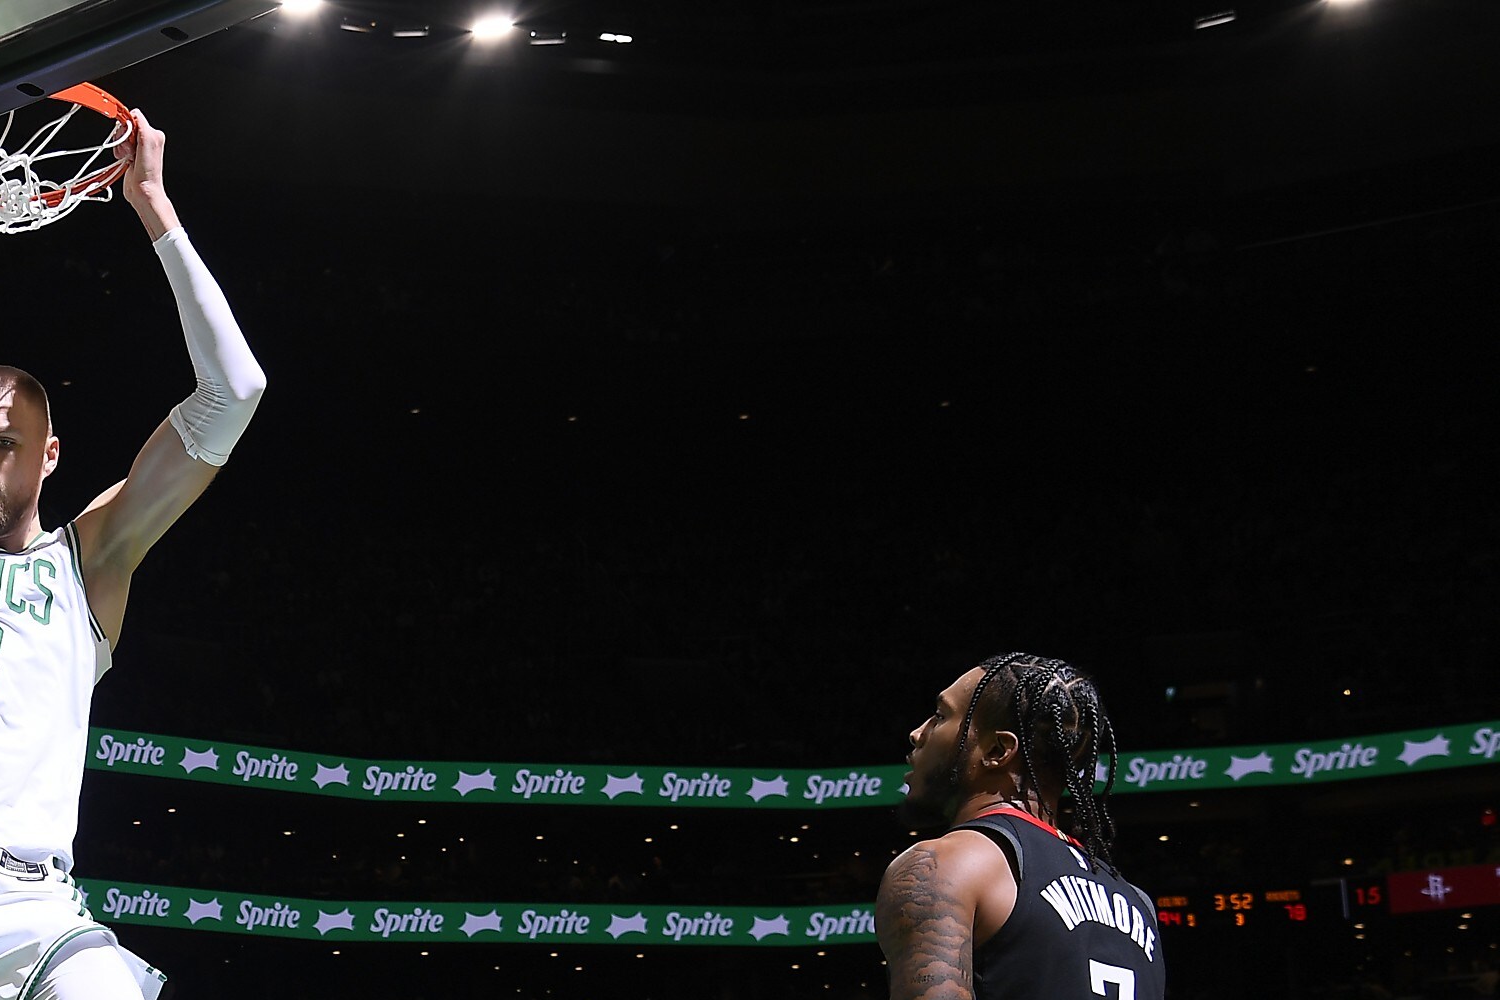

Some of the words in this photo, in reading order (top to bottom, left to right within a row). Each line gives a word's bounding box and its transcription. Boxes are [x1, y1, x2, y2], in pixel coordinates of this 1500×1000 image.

[95, 734, 165, 767] Sprite
[232, 750, 299, 782] Sprite
[1290, 743, 1378, 779] Sprite
[362, 765, 437, 796] Sprite
[511, 768, 586, 799] Sprite
[1125, 754, 1207, 788] Sprite
[658, 772, 732, 802] Sprite
[803, 772, 882, 805] Sprite
[102, 887, 170, 919] Sprite
[236, 900, 301, 930] Sprite
[369, 907, 444, 938] Sprite
[517, 909, 590, 939] Sprite
[662, 911, 734, 941] Sprite
